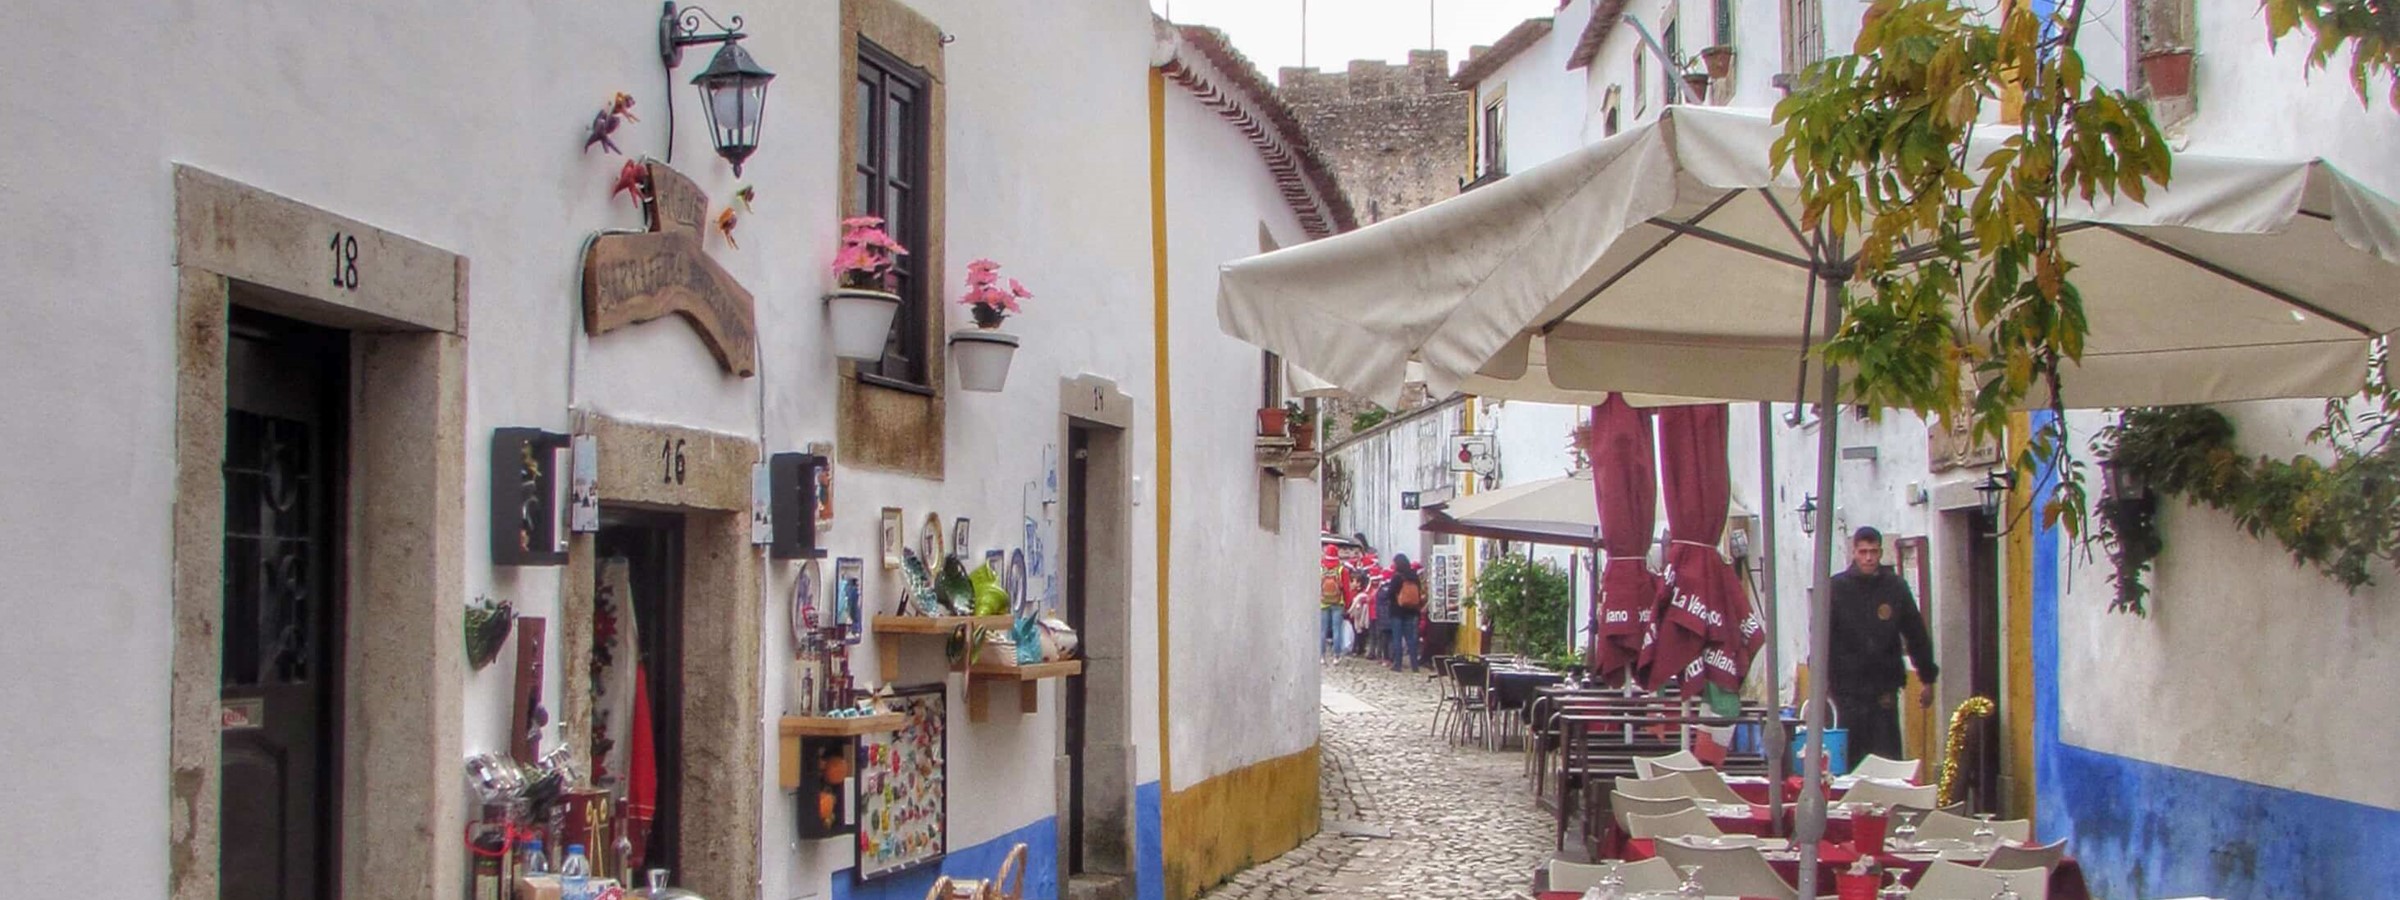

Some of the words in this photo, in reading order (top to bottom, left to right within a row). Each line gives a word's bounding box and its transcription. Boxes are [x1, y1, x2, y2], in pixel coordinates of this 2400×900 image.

[330, 231, 358, 290] 18
[662, 438, 686, 486] 16
[1671, 586, 1687, 609] La
